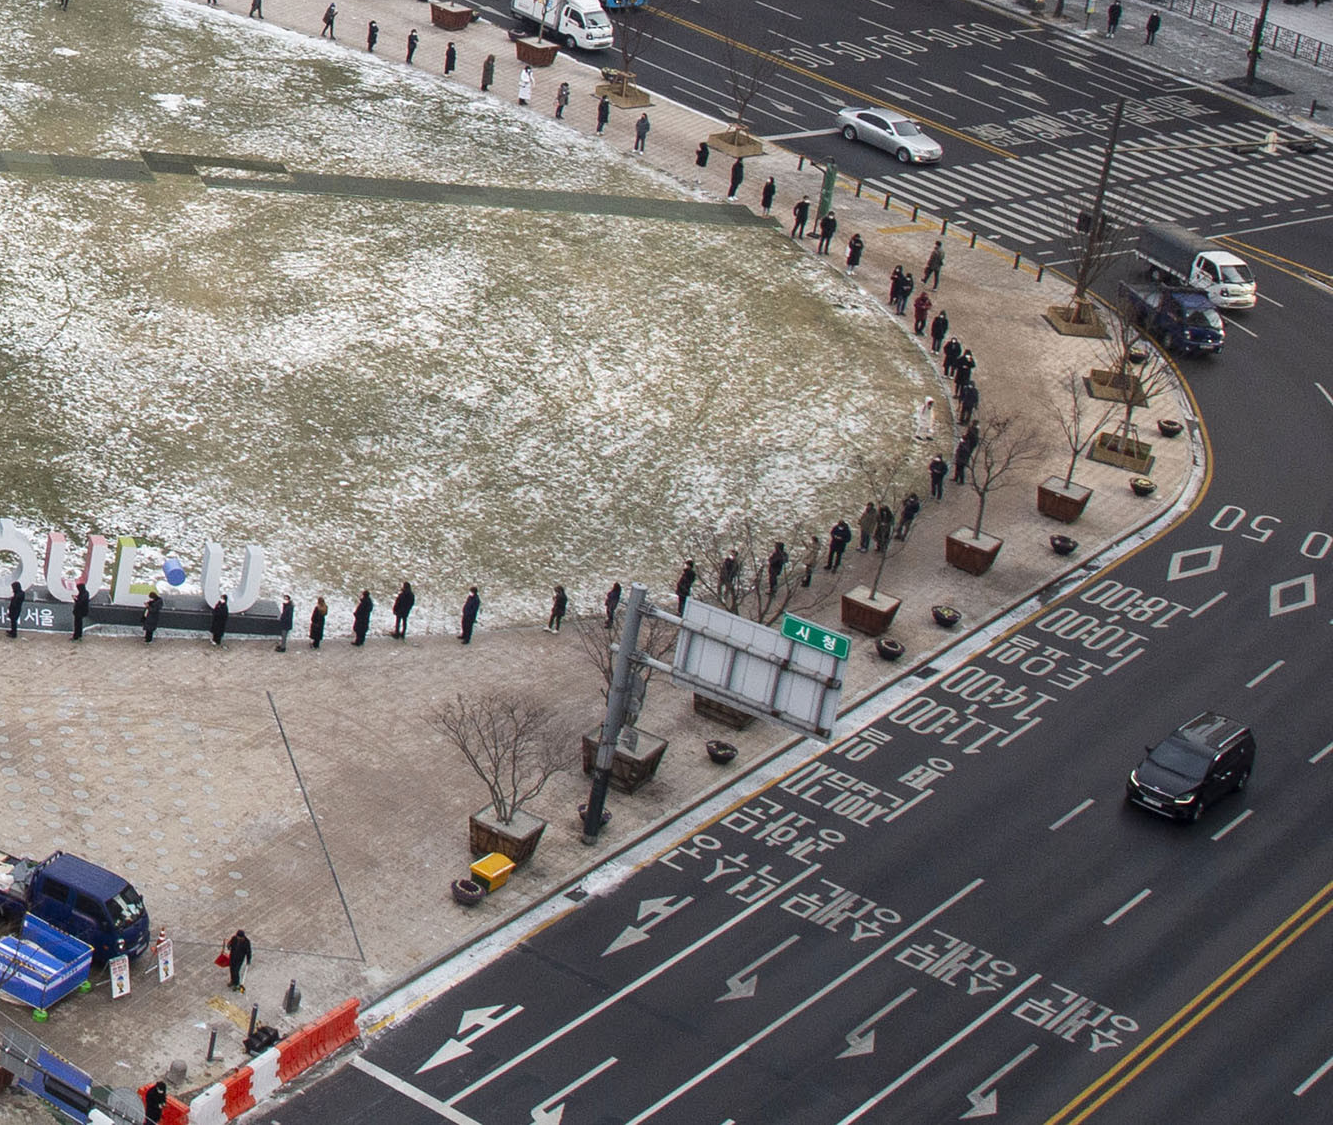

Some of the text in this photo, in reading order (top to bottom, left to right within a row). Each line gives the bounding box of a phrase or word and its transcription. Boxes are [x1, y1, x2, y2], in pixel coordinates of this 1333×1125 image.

[818, 41, 882, 62] 50
[865, 34, 929, 55] 50
[910, 28, 973, 48] 50
[953, 23, 1016, 42] 50
[1210, 505, 1282, 543] 50
[24, 608, 54, 627] 서울
[1079, 579, 1192, 629] 18:00
[1036, 607, 1149, 659] 10:00
[988, 634, 1103, 691] 토요일
[940, 665, 1058, 721] 14:00
[888, 696, 1009, 755] 11:00
[778, 761, 893, 827] 진입금지
[722, 796, 846, 864] 광화문
[659, 833, 779, 903] 덕수궁
[782, 879, 902, 943] 숭례문
[895, 929, 1018, 996] 숭례문
[1013, 982, 1139, 1053] 숭례문
